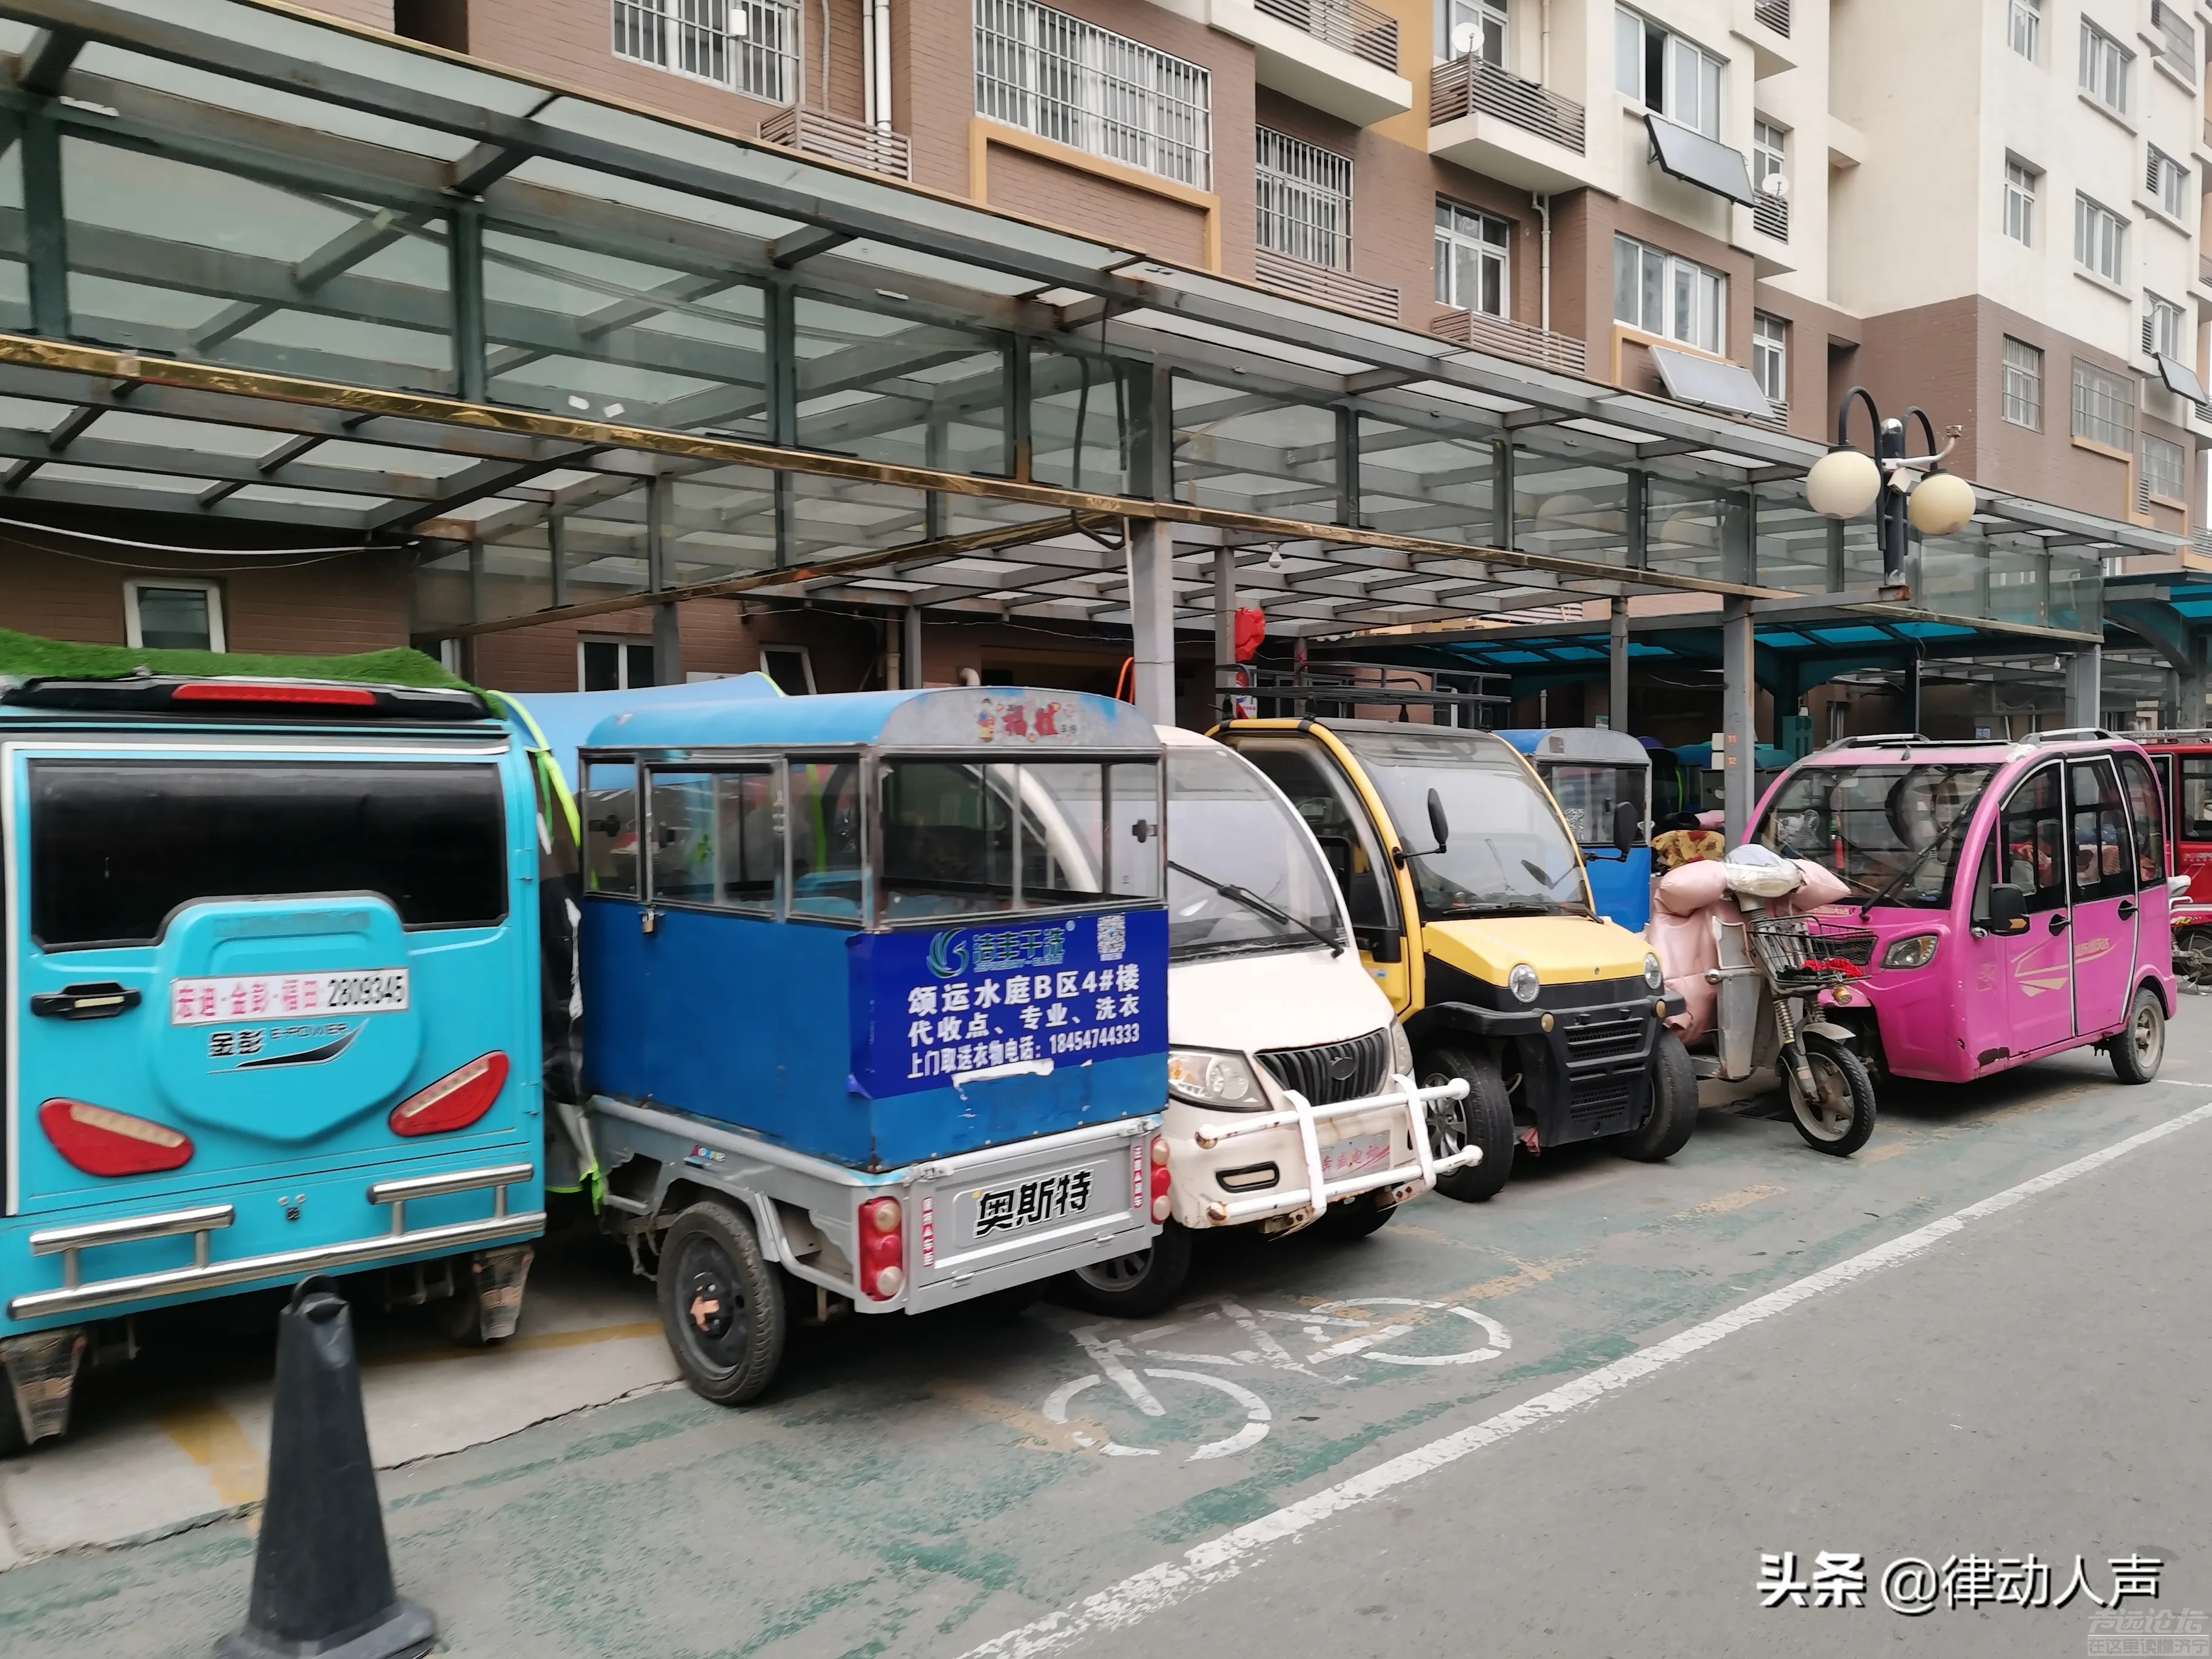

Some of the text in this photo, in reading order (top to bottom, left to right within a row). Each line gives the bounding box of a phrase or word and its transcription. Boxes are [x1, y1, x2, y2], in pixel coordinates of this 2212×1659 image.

[327, 976, 405, 1007] 2809345
[908, 964, 1139, 1017] 颂运水庭B区4#楼
[973, 1168, 1094, 1239] 奥斯特
